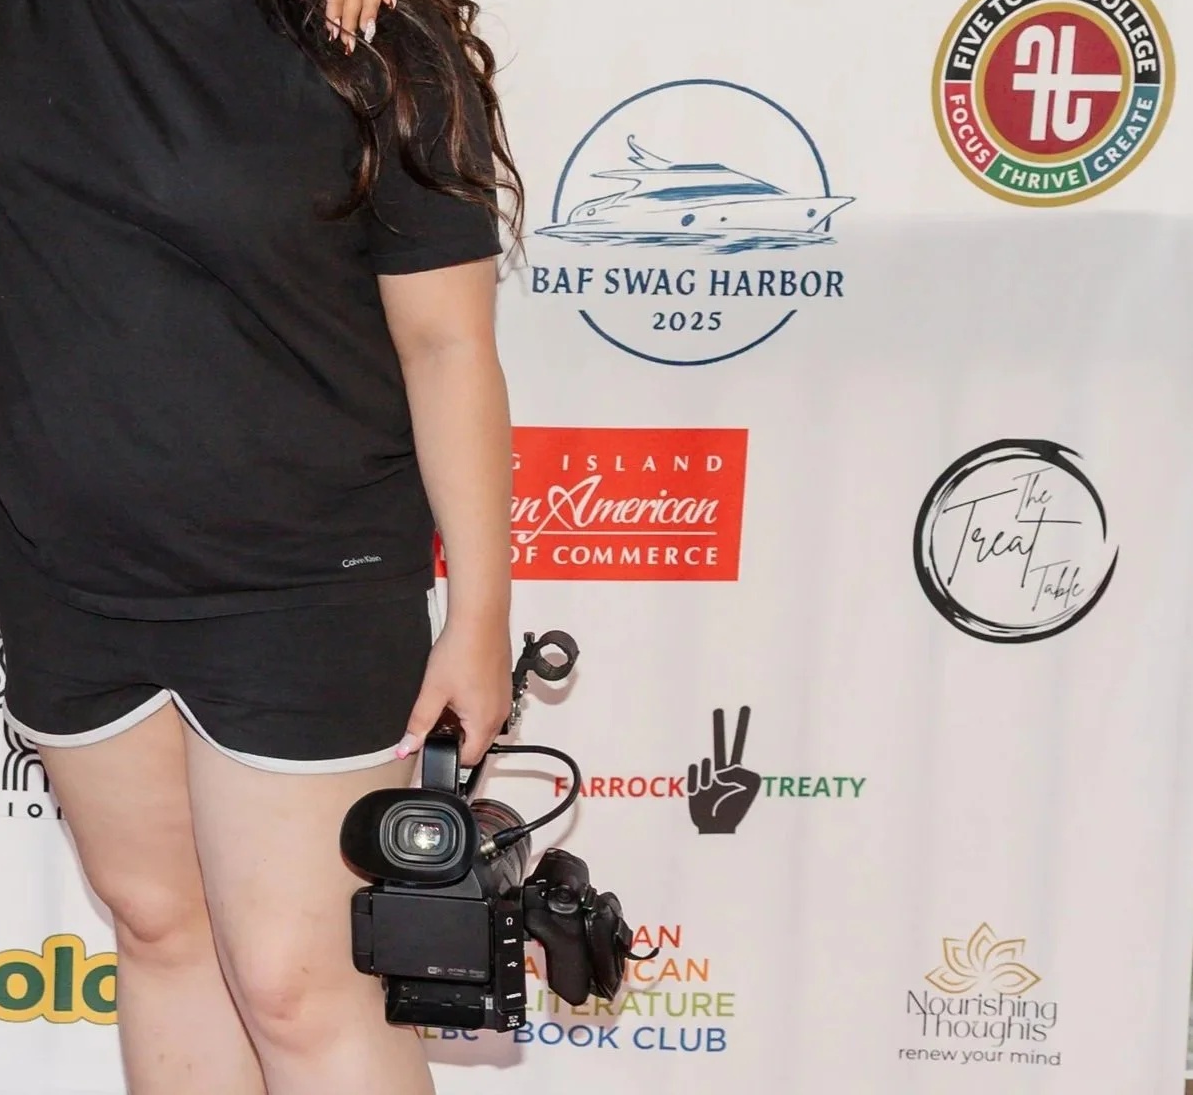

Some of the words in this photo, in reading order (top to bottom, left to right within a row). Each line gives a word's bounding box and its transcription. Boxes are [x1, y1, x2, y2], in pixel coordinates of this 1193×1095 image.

[953, 15, 994, 71] FIVE
[949, 94, 991, 164] FOCUS
[1094, 97, 1153, 172] CREATE
[1000, 163, 1080, 189] THRIVE
[532, 267, 594, 294] BAF
[605, 268, 696, 296] SWAG
[709, 270, 844, 298] HARBOR
[652, 311, 722, 331] 2025
[562, 454, 723, 473] ISLAND
[1012, 466, 1054, 520] The
[517, 475, 719, 544] American
[942, 488, 1082, 589] Treat
[552, 545, 719, 566] COMMERCE
[1030, 560, 1084, 612] Table
[761, 776, 867, 798] TREATY
[526, 989, 736, 1017] ITERATURE
[906, 990, 1058, 1029] Nourishing
[513, 1022, 619, 1049] BOOK
[633, 1026, 727, 1052] CLUB
[898, 1047, 958, 1060] renew
[959, 1049, 1004, 1065] your
[1010, 1048, 1062, 1066] mind
